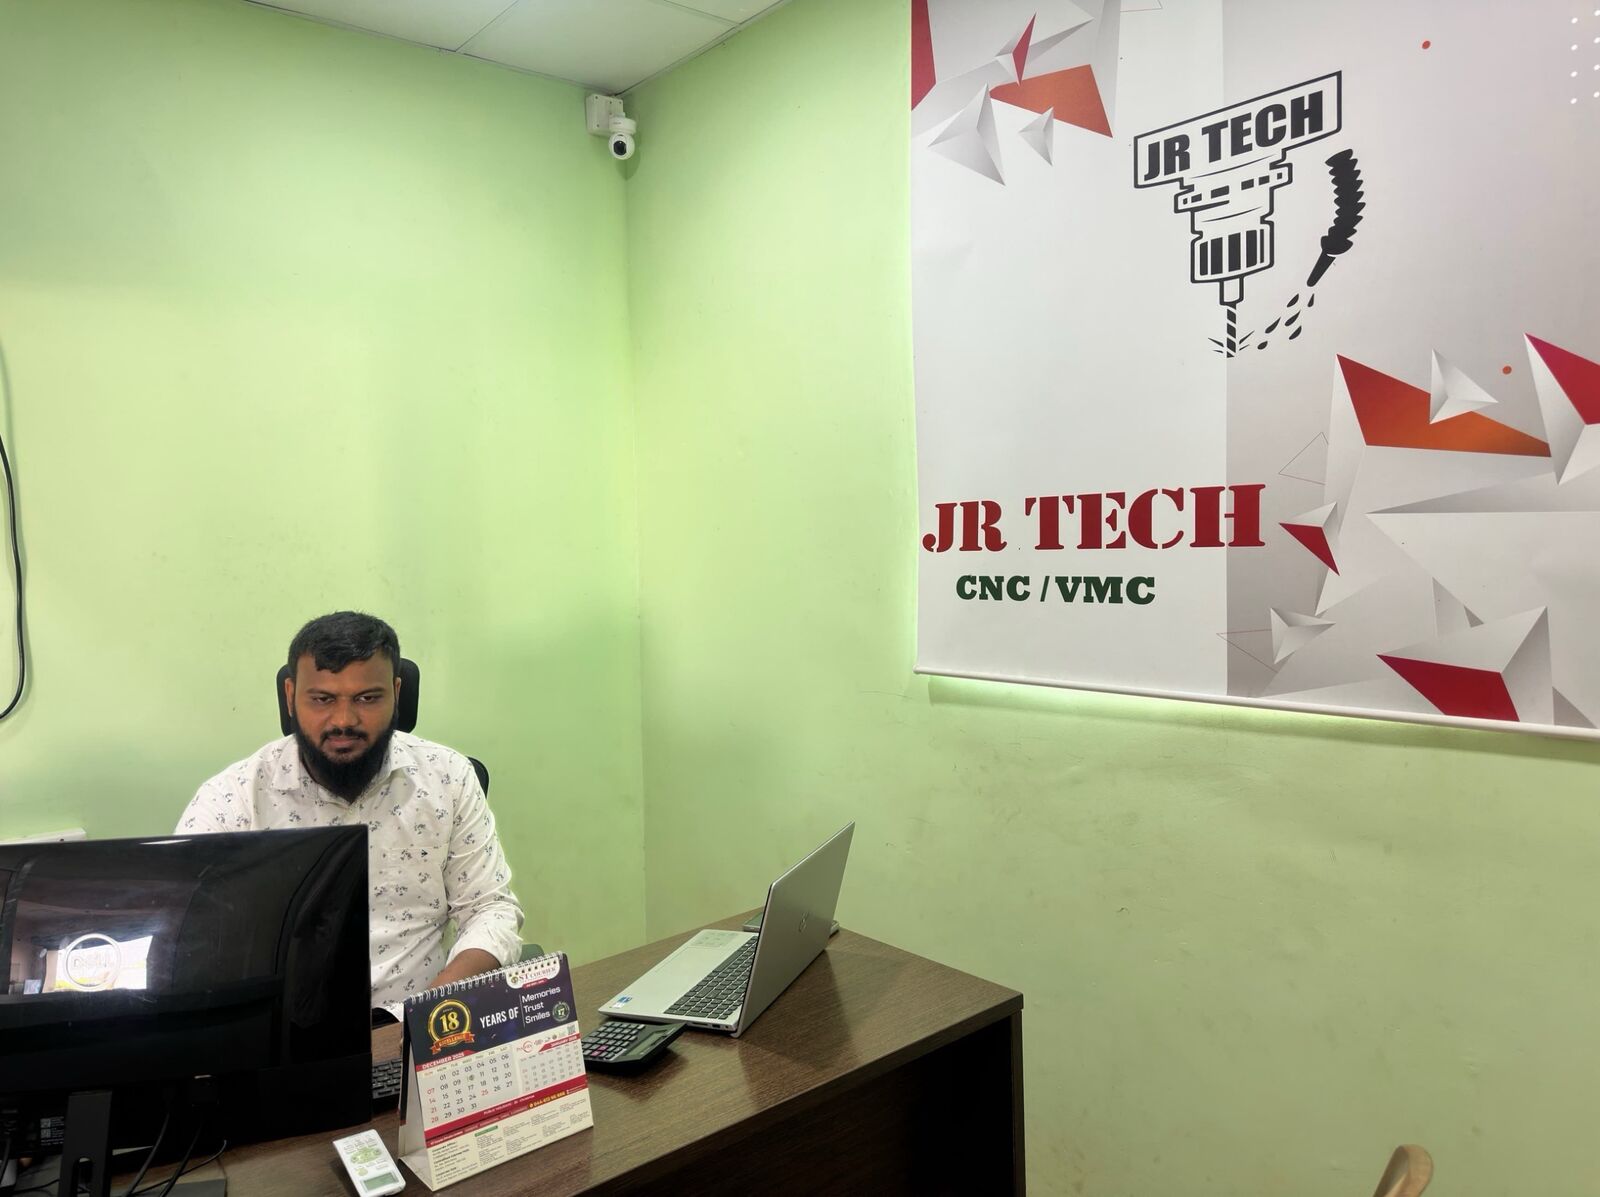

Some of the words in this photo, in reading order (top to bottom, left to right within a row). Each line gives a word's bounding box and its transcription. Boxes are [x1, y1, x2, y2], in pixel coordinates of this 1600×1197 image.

[1144, 134, 1190, 181] JR
[1201, 90, 1323, 163] TECH
[922, 500, 1008, 553] JR
[1025, 483, 1266, 550] TECH
[956, 574, 1031, 601] CNC
[521, 986, 561, 1003] Memories
[523, 1001, 544, 1013] Trust
[440, 1011, 460, 1033] 18
[479, 1010, 507, 1029] YEARS
[508, 1006, 519, 1020] OF
[525, 1010, 551, 1024] Smiles
[422, 1055, 452, 1069] DECEMBER
[504, 1071, 512, 1079] 20
[444, 1111, 452, 1119] 29
